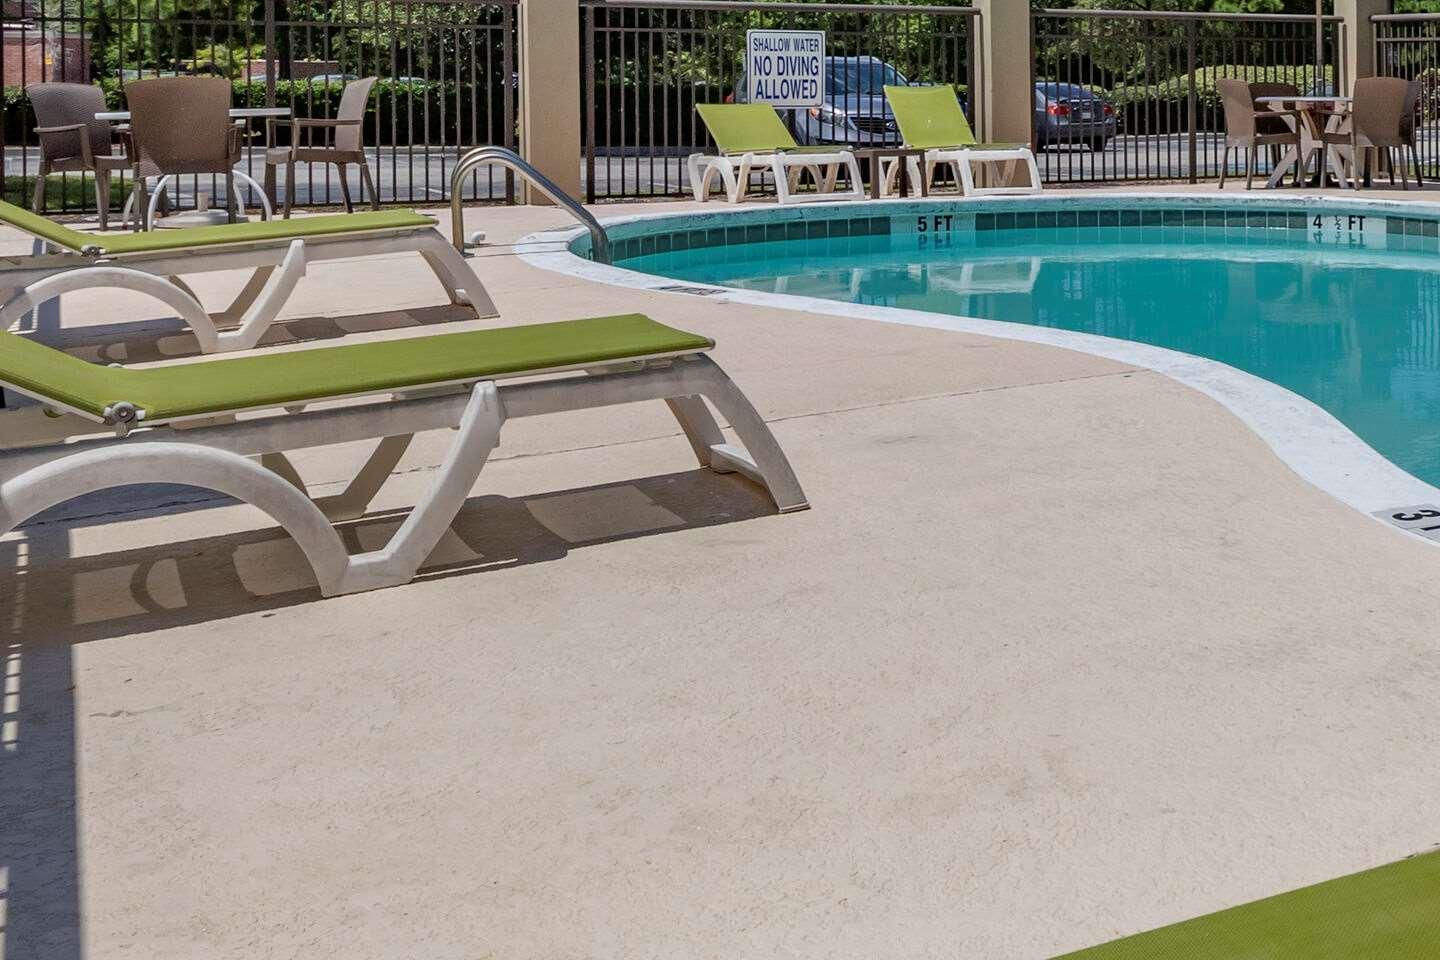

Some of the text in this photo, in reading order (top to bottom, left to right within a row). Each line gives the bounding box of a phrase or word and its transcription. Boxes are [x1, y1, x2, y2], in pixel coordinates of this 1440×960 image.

[753, 38, 819, 52] SHALLOW WATER
[754, 56, 819, 76] NO DIVING
[756, 79, 817, 99] ALLOWED
[918, 215, 953, 232] 5 FT
[1313, 214, 1322, 229] 4
[1348, 214, 1366, 231] FT
